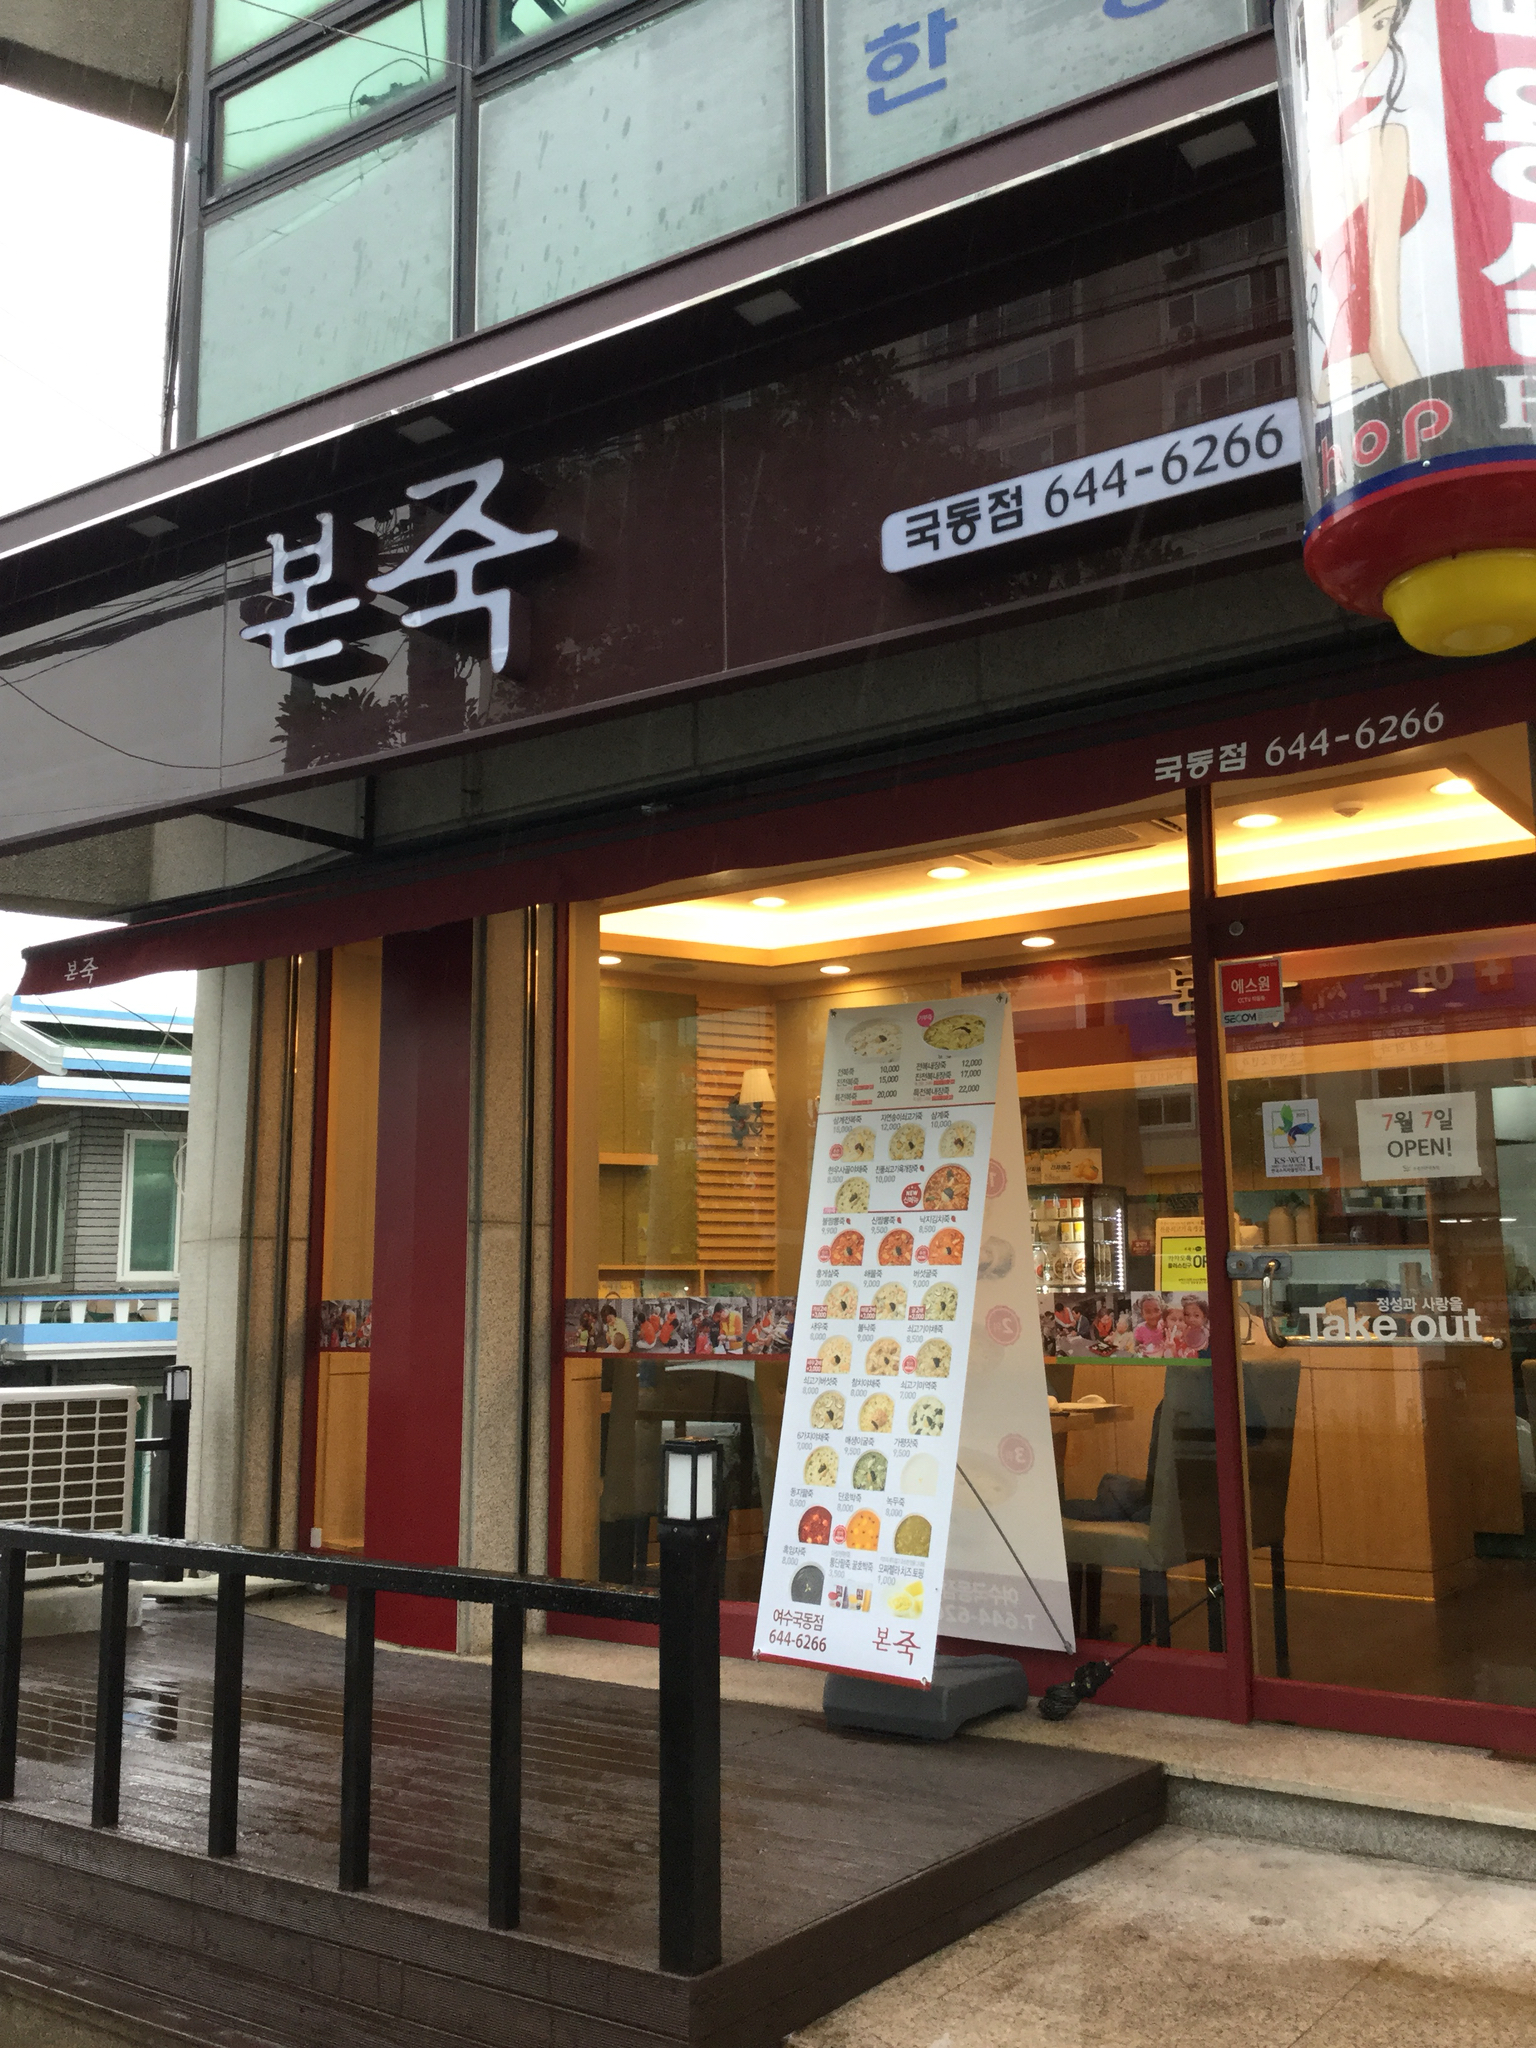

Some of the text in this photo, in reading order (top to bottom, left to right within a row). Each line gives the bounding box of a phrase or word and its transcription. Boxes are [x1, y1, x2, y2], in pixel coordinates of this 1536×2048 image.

[864, 7, 958, 117] 한
[905, 414, 1283, 551] 국동점 644-6266
[240, 458, 558, 673] 본죽
[1154, 702, 1444, 783] 국동점 644-6266
[64, 957, 98, 983] 본죽
[1231, 976, 1270, 994] 에스원
[1224, 1013, 1257, 1024] SECOM
[962, 1059, 982, 1068] 12,000
[837, 1065, 900, 1076] 전복죽 10,000
[960, 1070, 981, 1078] 17,000
[879, 1075, 899, 1084] 15,000
[958, 1084, 980, 1093] 22,000
[877, 1089, 897, 1099] 20,000
[931, 1120, 951, 1129] 10,000
[1382, 1108, 1453, 1133] 7월 7일
[881, 1123, 901, 1131] 12,000
[1387, 1137, 1453, 1158] OPEN!
[1274, 1156, 1307, 1165] KS-WCI
[875, 1175, 896, 1184] 10,000
[919, 1214, 950, 1224] 낙지김치죽
[821, 1226, 838, 1235] 9,900
[871, 1226, 888, 1234] 9,500
[919, 1225, 936, 1233] 8,500
[815, 1279, 832, 1288] 9,000
[863, 1279, 880, 1288] 9,000
[912, 1279, 930, 1287] 9,000
[1376, 1296, 1464, 1313] 정성과 사랑을
[810, 1322, 829, 1331] 새우죽
[907, 1324, 944, 1334] 쇠고기야채죽
[1299, 1307, 1483, 1343] Take out
[810, 1333, 827, 1341] 8,000
[857, 1333, 874, 1342] 9,000
[906, 1334, 924, 1343] 8,500
[803, 1376, 838, 1386] 쇠고기버섯죽
[900, 1380, 938, 1391] 쇠고기미역죽
[802, 1387, 819, 1395] 8,000
[850, 1388, 867, 1397] 8,000
[900, 1391, 917, 1400] 7,000
[797, 1432, 831, 1442] 6가지야채죽
[844, 1436, 875, 1447] 매생이굴죽
[797, 1442, 813, 1450] 7,000
[844, 1447, 861, 1456] 9,500
[893, 1449, 911, 1458] 9,500
[838, 1492, 862, 1503] 단호박죽
[886, 1496, 905, 1507] 녹두죽
[789, 1499, 806, 1507] 8,500
[837, 1503, 854, 1512] 8,000
[885, 1508, 903, 1517] 8,000
[782, 1557, 799, 1566] 8,000
[828, 1569, 845, 1579] 3,500
[877, 1576, 896, 1586] 1,000
[773, 1608, 824, 1631] 여수국동점
[769, 1629, 827, 1652] 644-6266
[872, 1627, 921, 1666] 본죽
